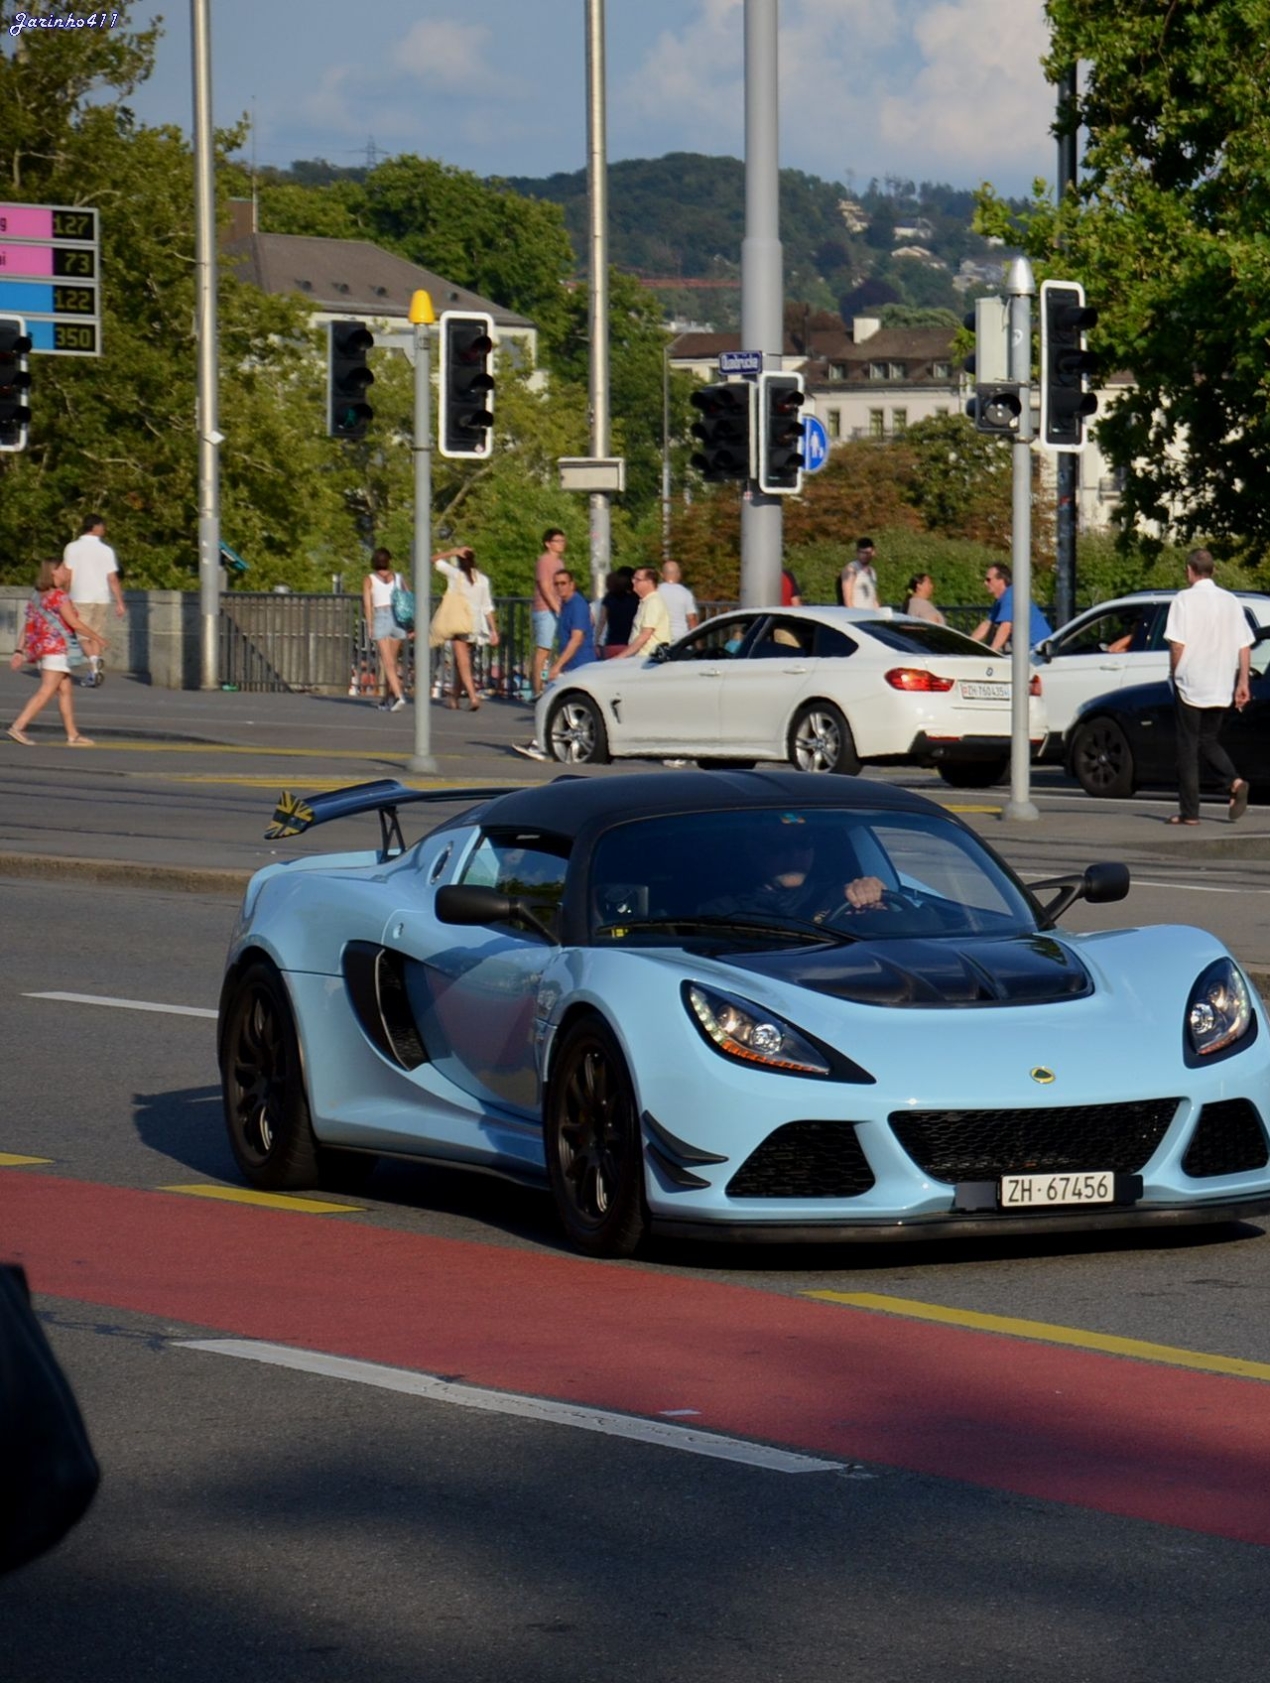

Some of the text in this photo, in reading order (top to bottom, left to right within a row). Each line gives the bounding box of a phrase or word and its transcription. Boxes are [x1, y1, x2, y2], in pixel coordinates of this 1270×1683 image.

[54, 215, 89, 235] 127
[65, 253, 90, 273] 73
[54, 290, 91, 310] 122
[55, 327, 91, 348] 350
